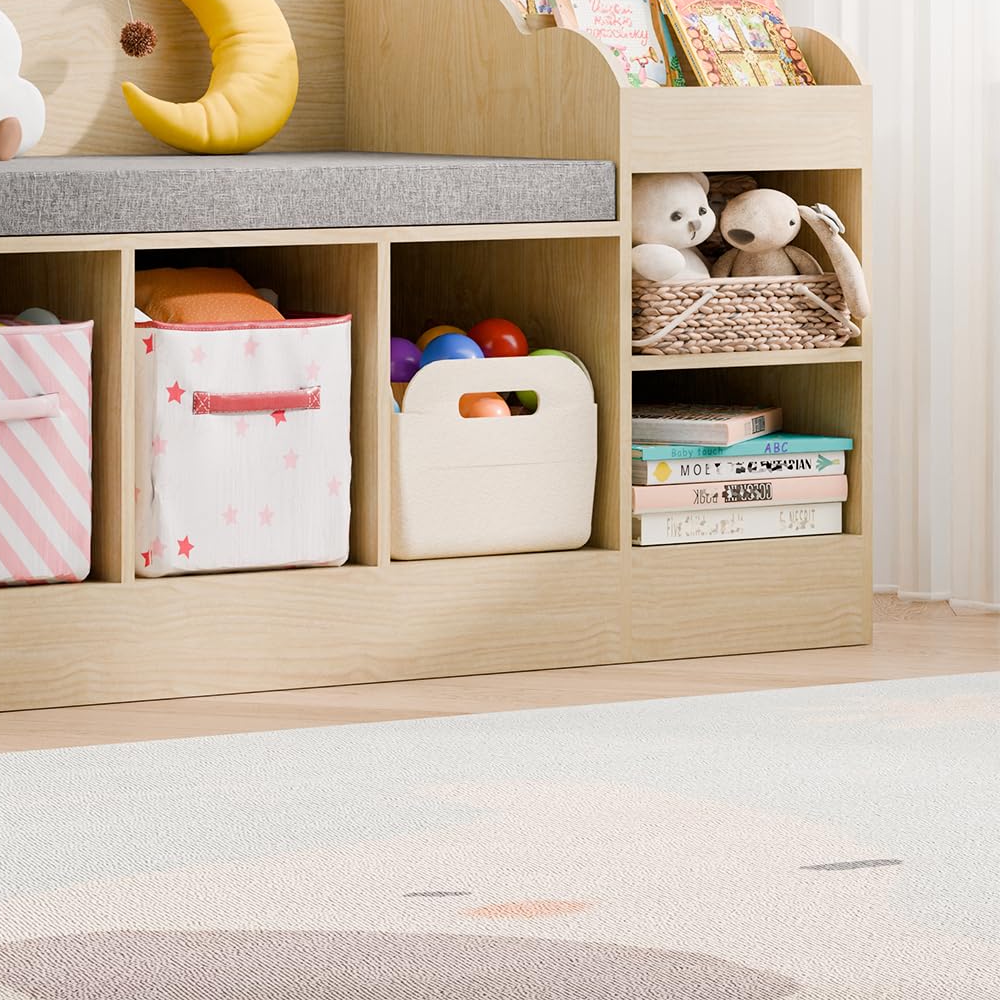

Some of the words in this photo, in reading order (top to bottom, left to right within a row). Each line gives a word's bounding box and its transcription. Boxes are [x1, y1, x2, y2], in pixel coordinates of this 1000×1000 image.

[671, 448, 694, 458] Baby
[698, 446, 724, 456] touch
[764, 442, 789, 453] ABC
